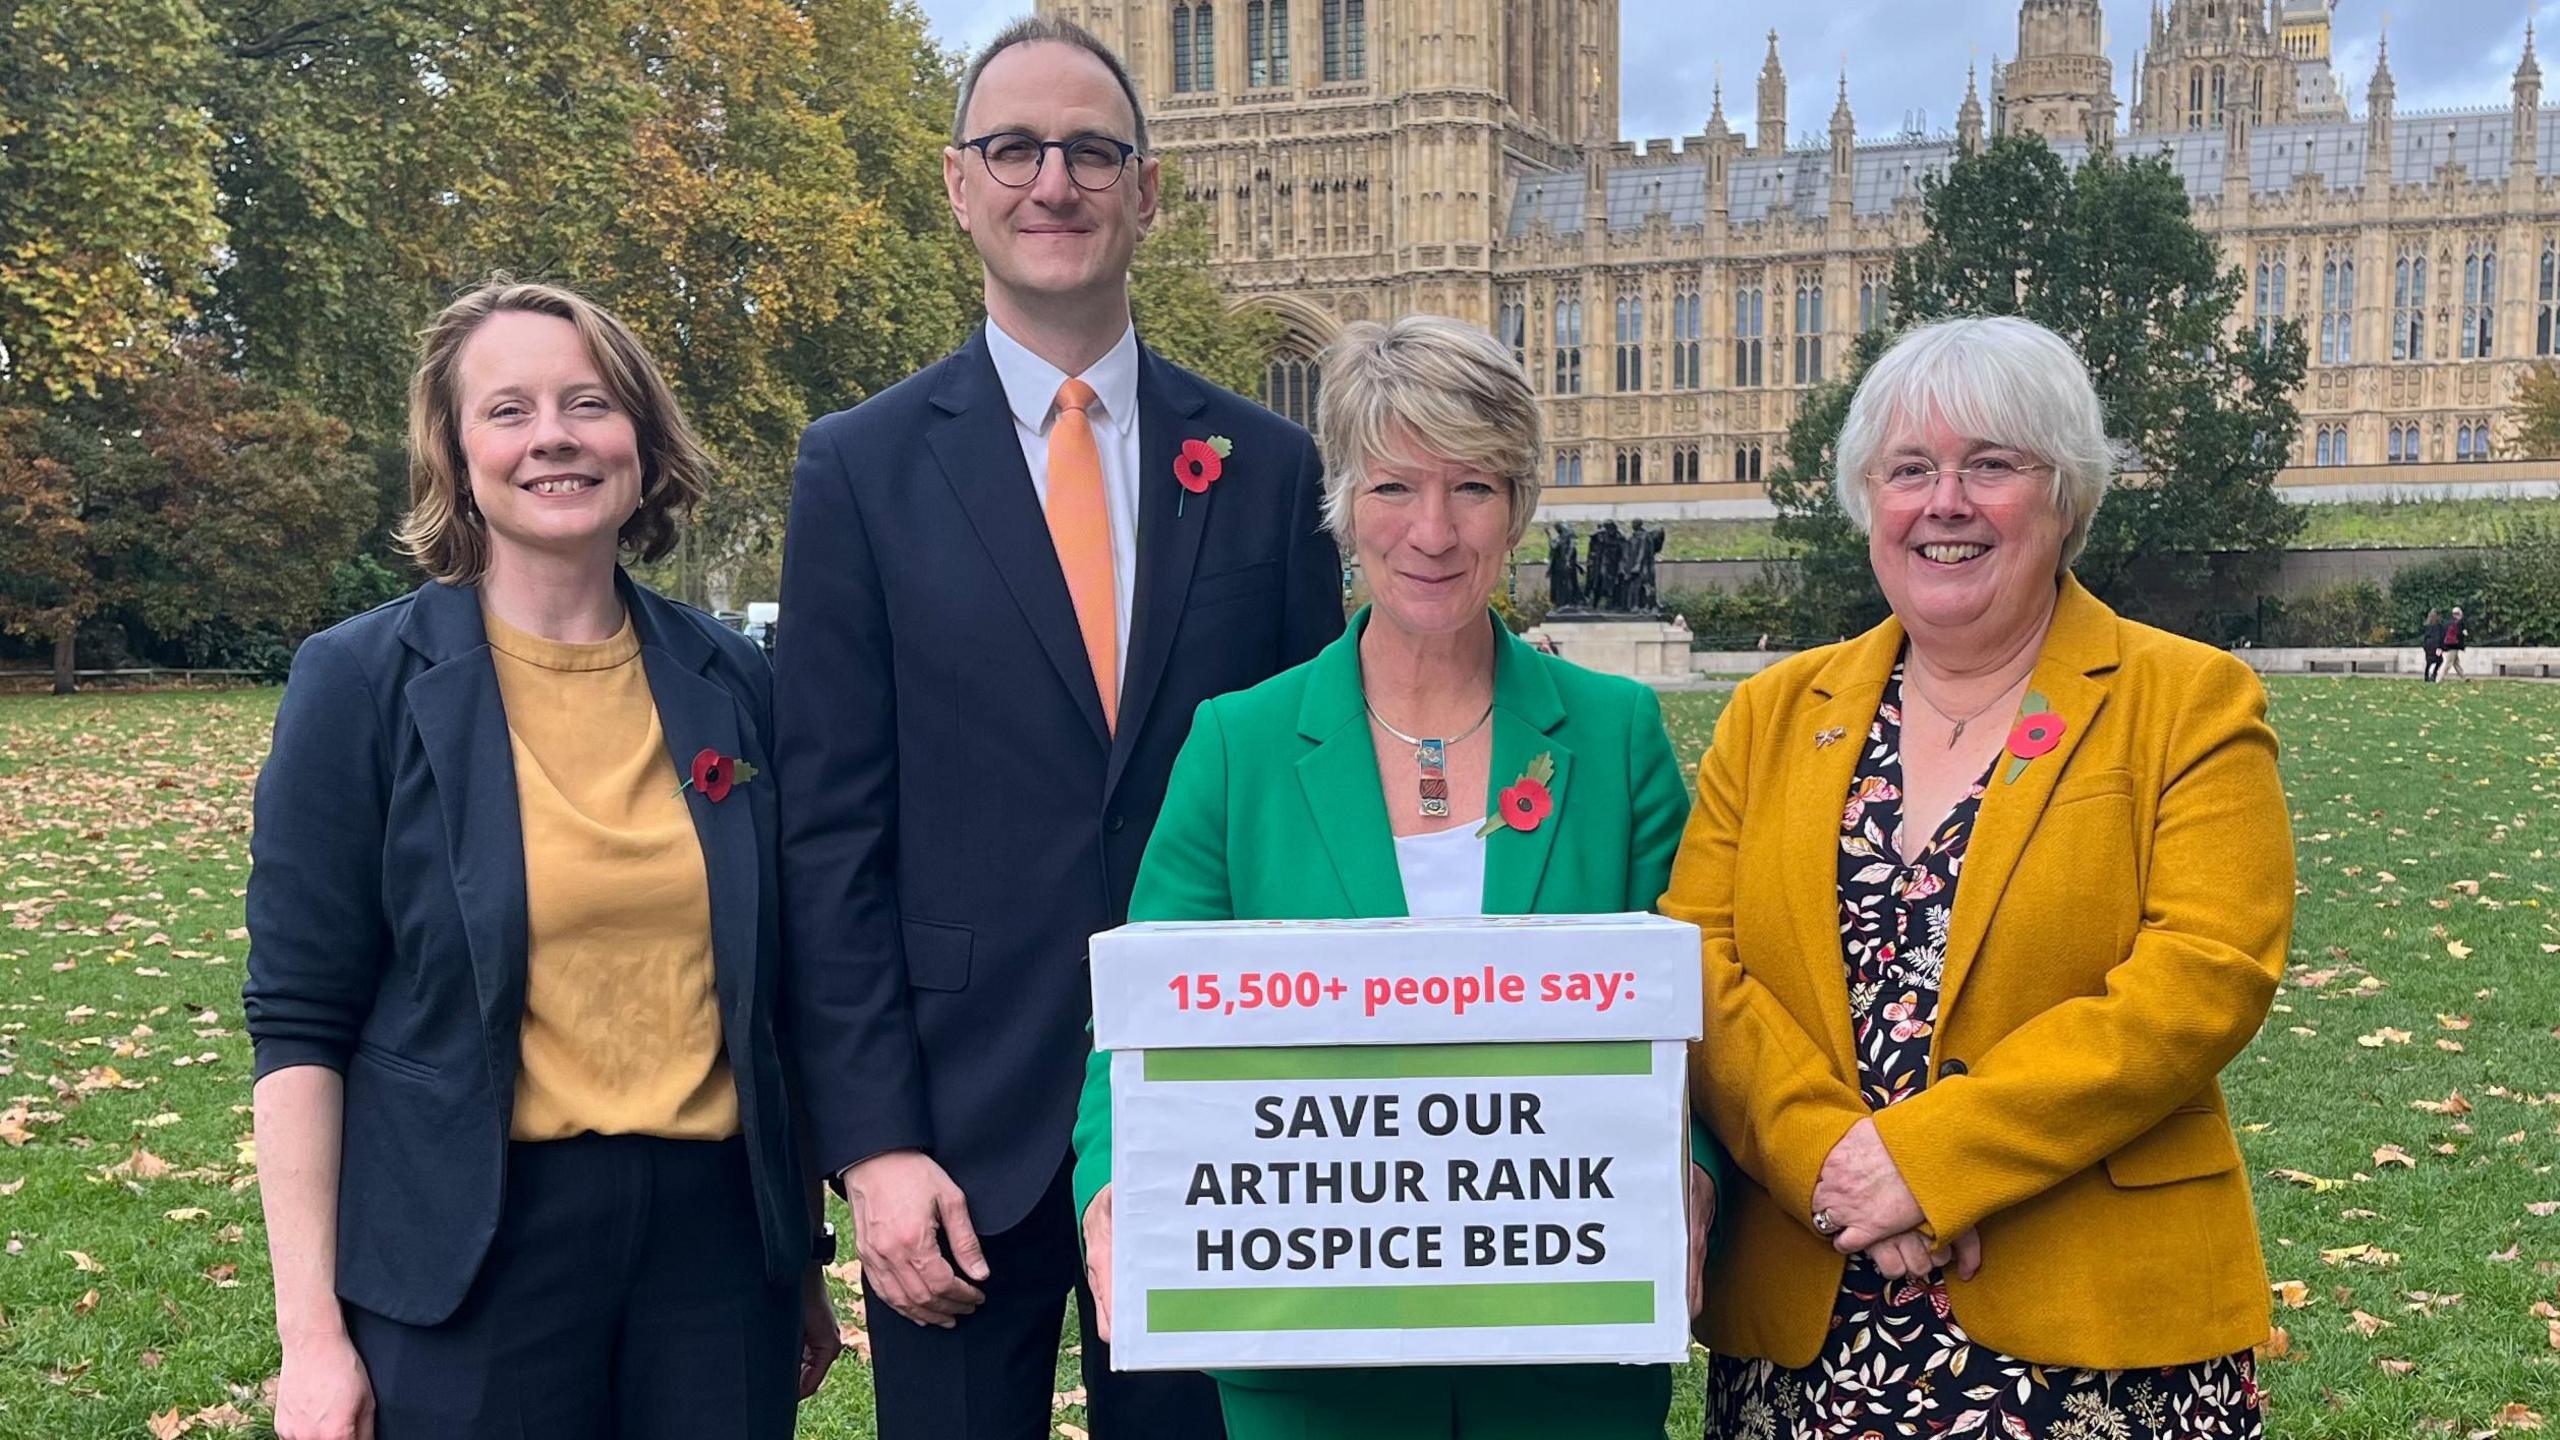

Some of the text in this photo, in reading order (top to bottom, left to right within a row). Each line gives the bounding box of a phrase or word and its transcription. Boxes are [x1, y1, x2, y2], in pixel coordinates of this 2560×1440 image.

[1168, 965, 1635, 1018] 15,500+ people say:
[1255, 1092, 1545, 1139] SAVE OUR
[1185, 1157, 1614, 1206] ARTHUR RANK
[1197, 1222, 1606, 1271] HOSPICE BEDS
